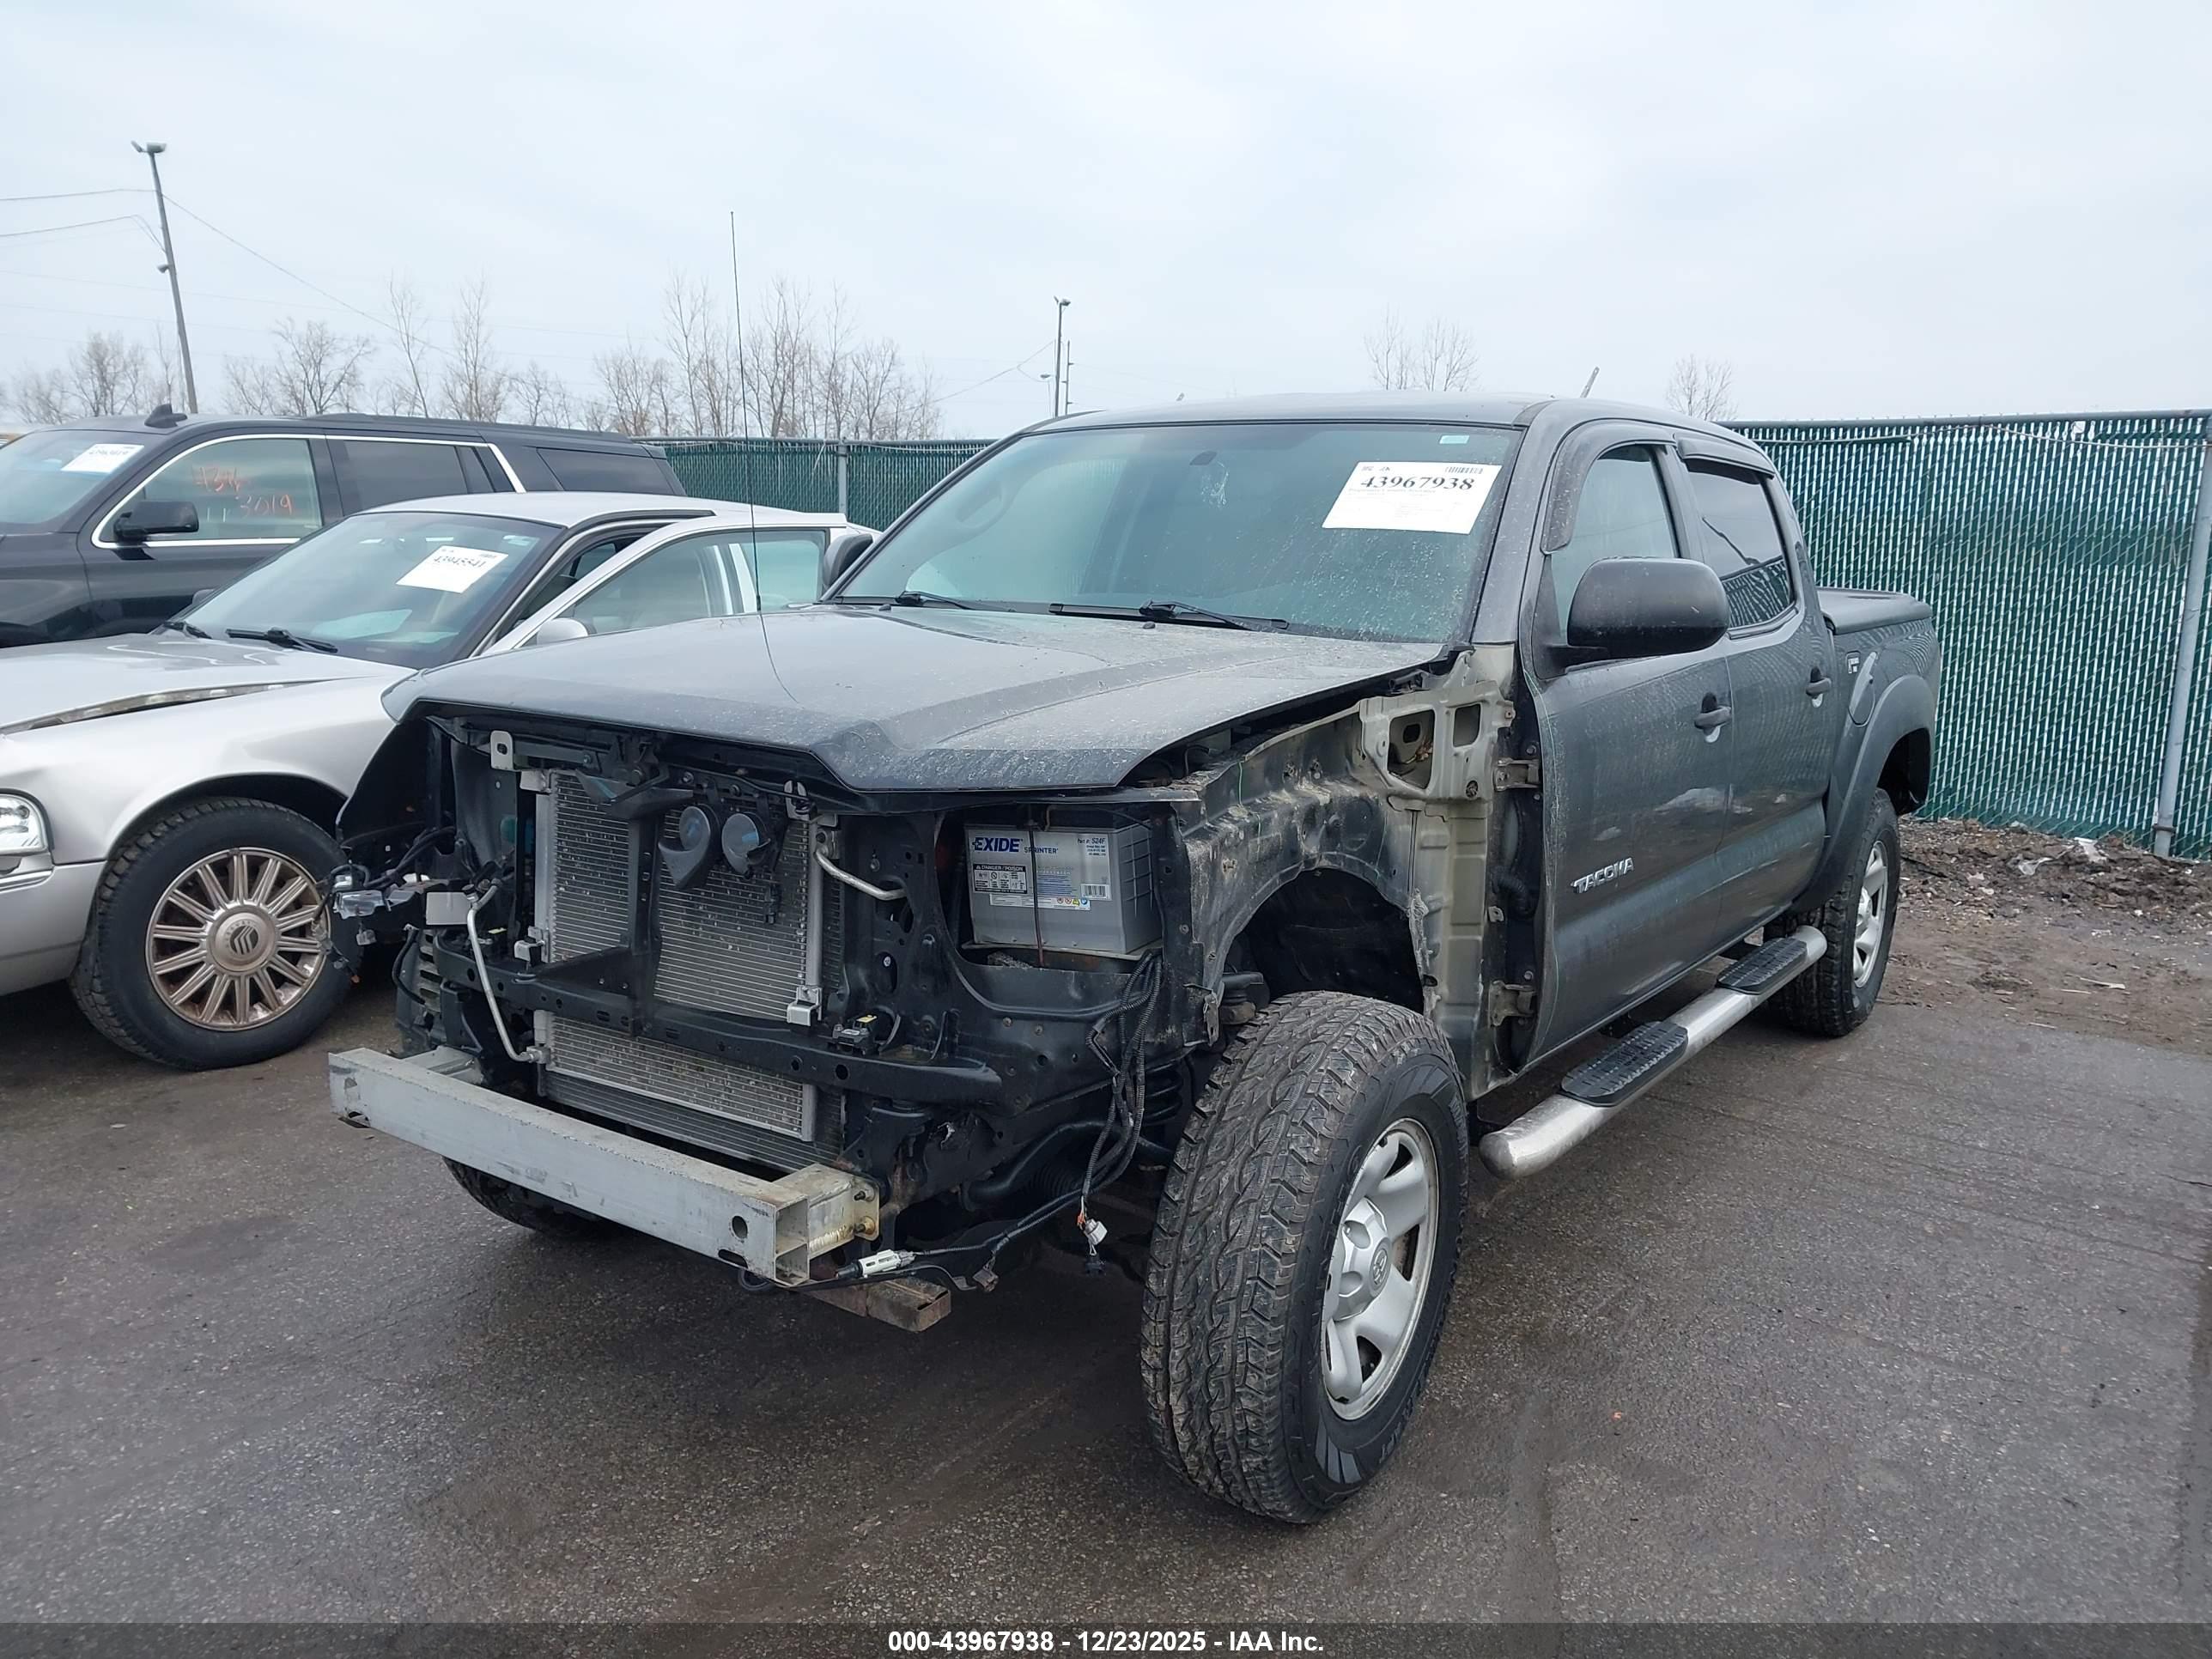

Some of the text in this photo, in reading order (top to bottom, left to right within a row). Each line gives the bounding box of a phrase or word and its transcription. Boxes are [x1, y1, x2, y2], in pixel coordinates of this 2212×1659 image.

[1360, 476, 1475, 490] 43967938
[972, 837, 1020, 853] EXIDE
[1572, 857, 1634, 894] TACOMA
